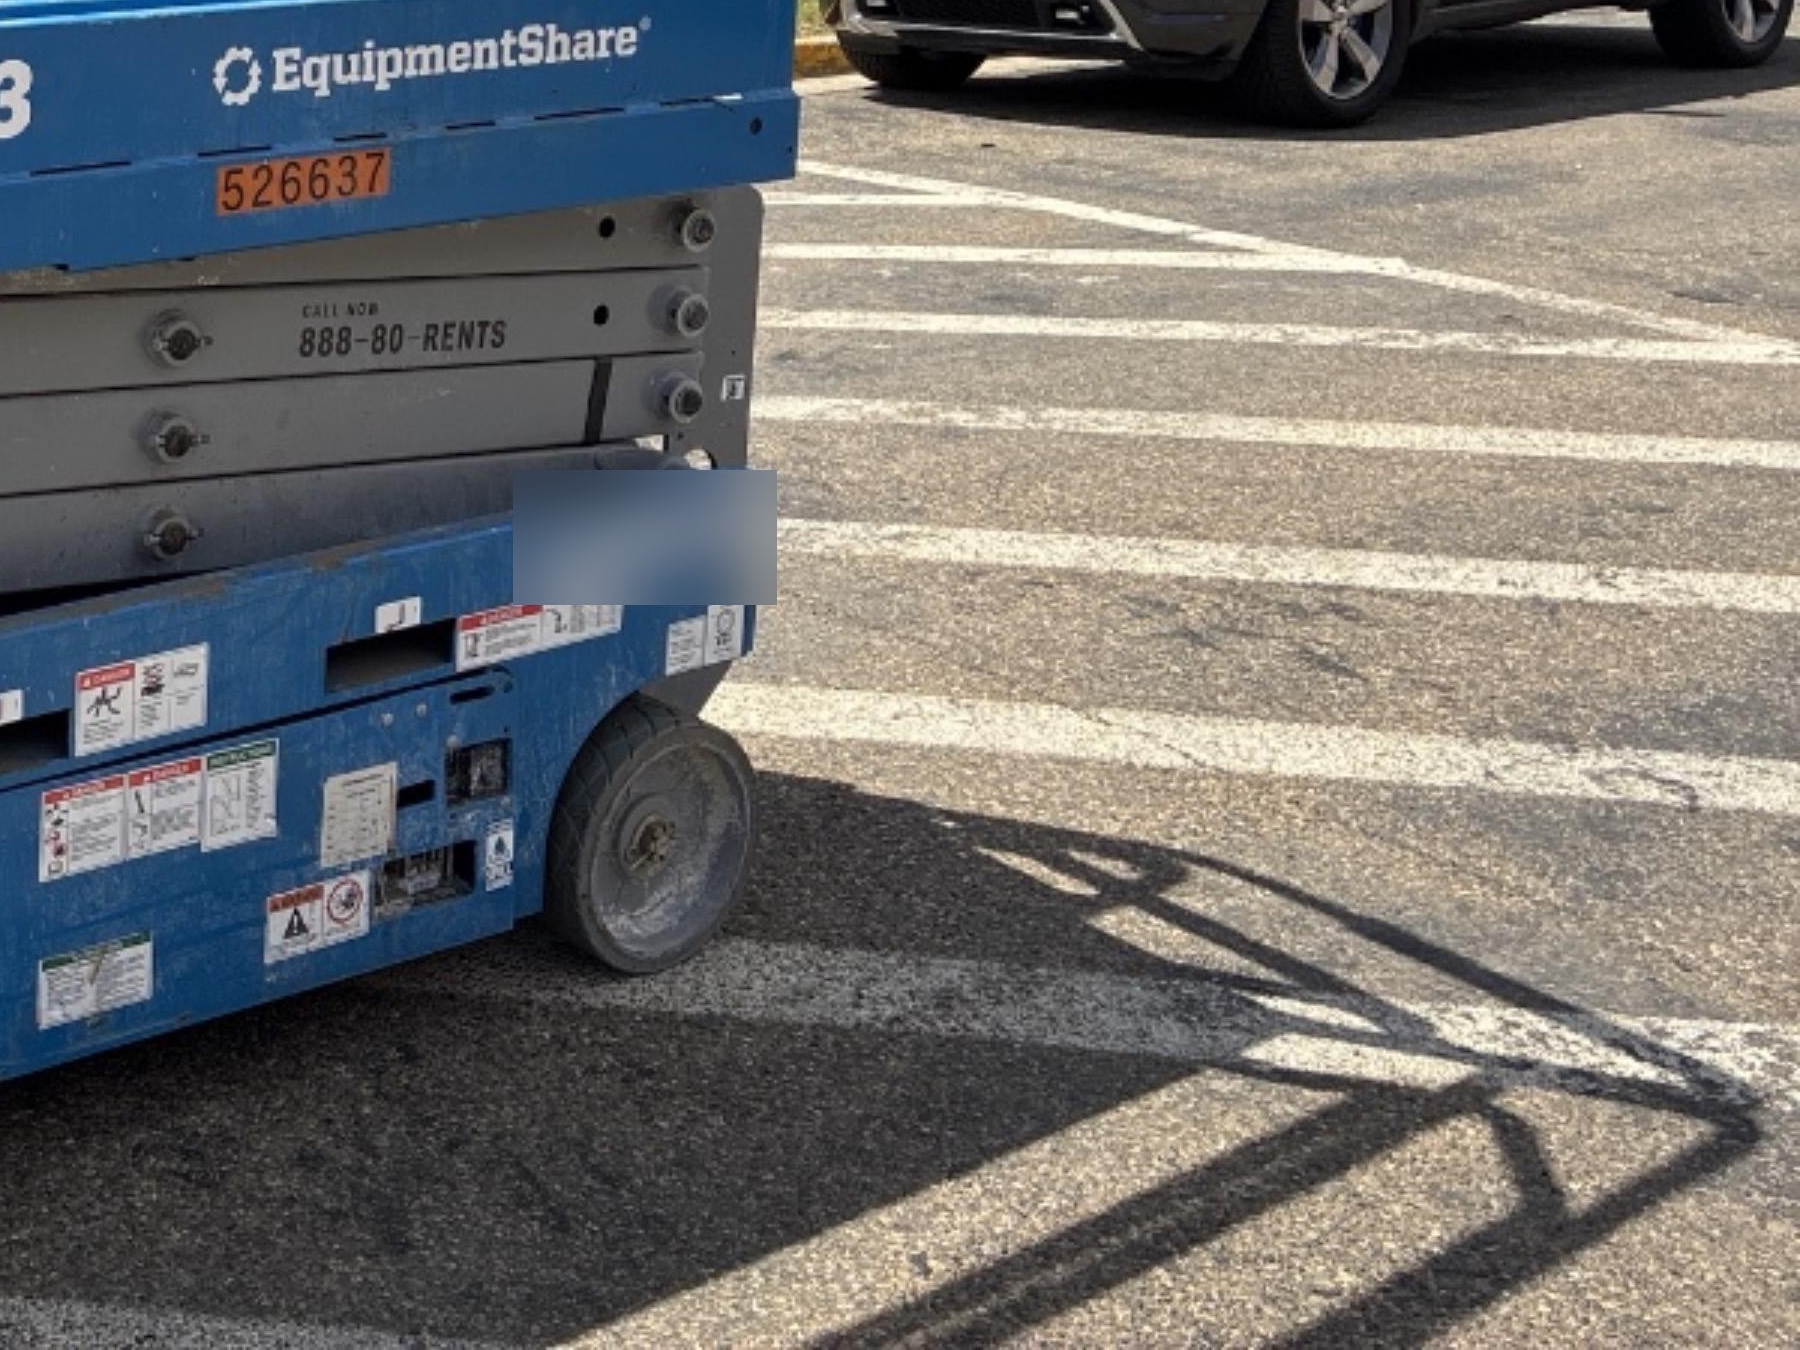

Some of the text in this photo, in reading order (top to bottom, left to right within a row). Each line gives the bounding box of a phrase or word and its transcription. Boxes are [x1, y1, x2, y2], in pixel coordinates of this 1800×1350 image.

[271, 20, 640, 99] EquipmentShare
[221, 151, 387, 212] 526637
[302, 302, 379, 319] CALL NOW
[299, 319, 508, 358] 888-80-RENTS
